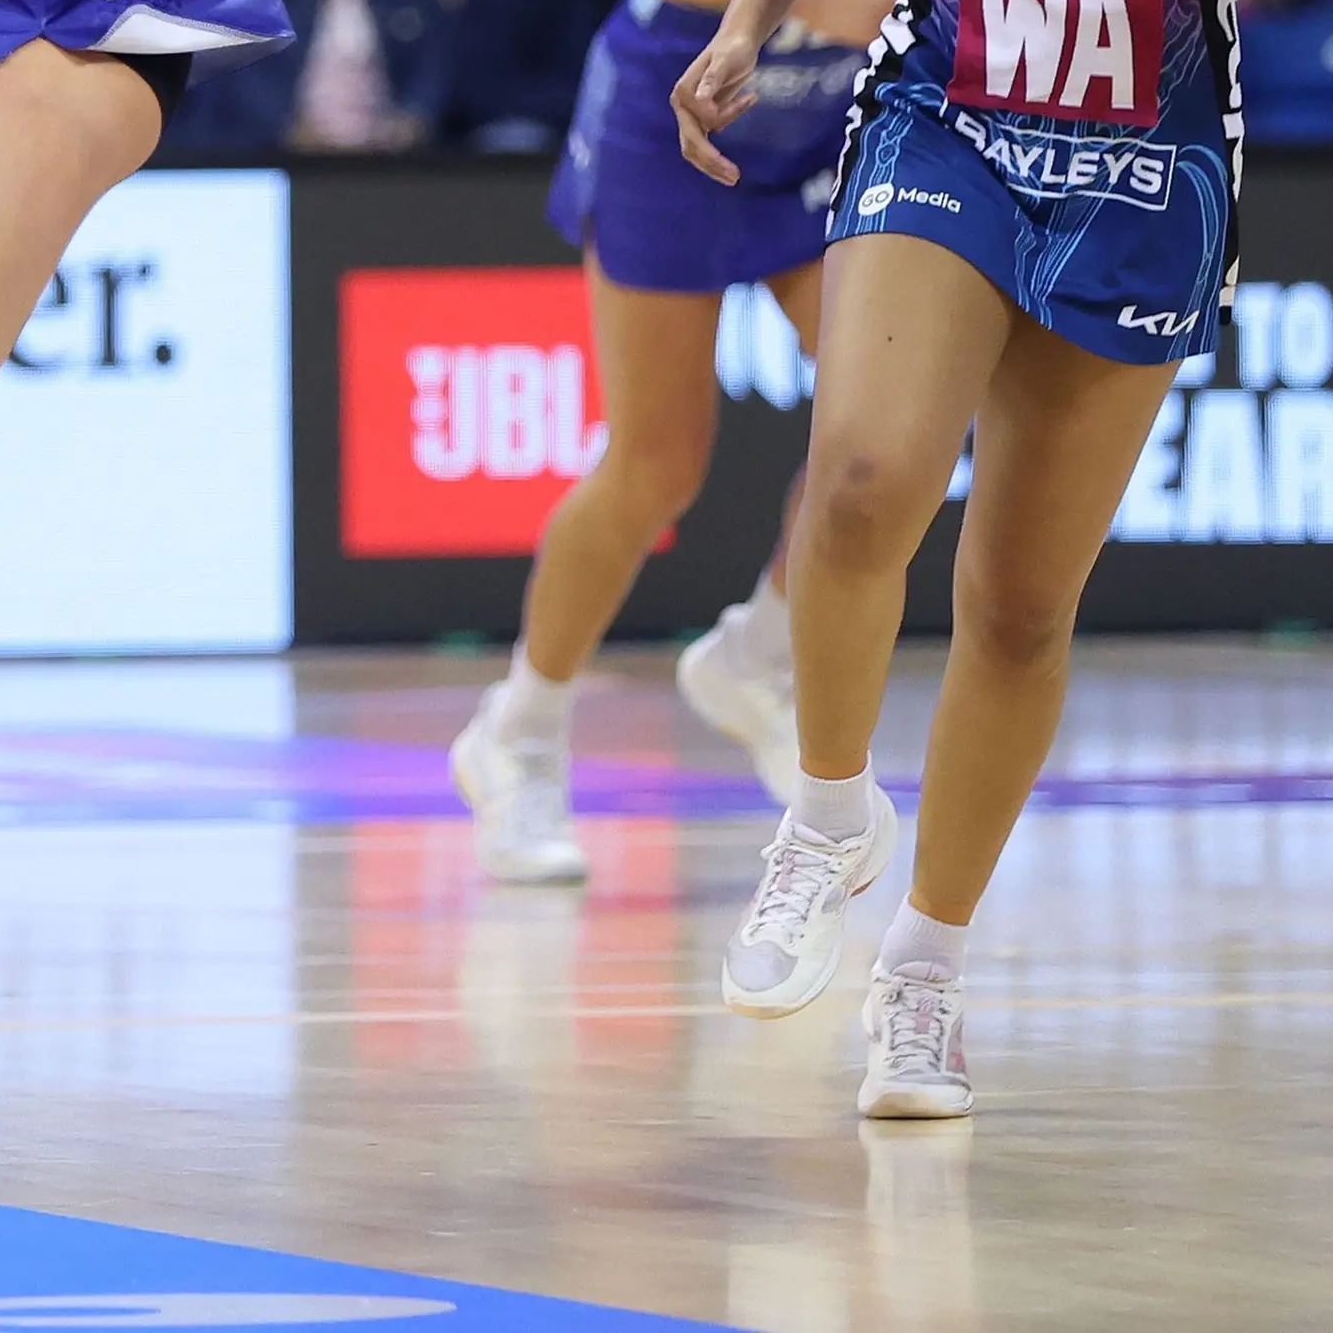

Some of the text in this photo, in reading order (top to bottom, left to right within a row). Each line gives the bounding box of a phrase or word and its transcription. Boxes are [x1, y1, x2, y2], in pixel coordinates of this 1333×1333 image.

[861, 189, 891, 209] GO
[897, 186, 963, 214] Media
[955, 111, 1164, 195] BAYLEYS
[1233, 279, 1333, 389] TO
[407, 344, 610, 480] JBL
[1107, 388, 1333, 543] EAR
